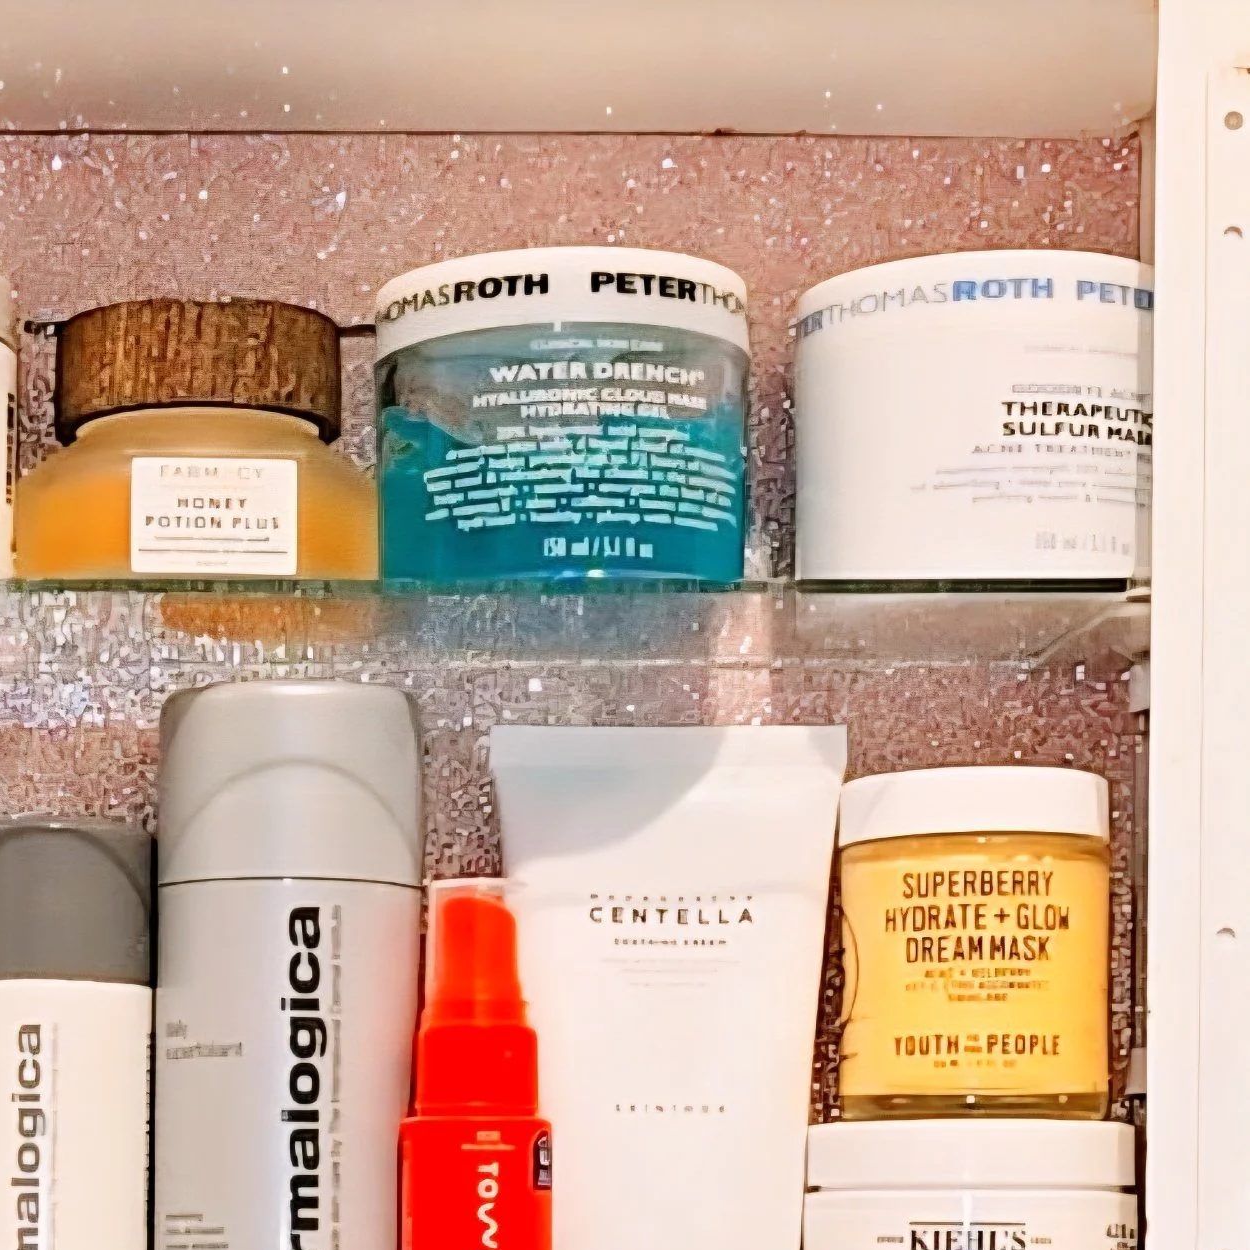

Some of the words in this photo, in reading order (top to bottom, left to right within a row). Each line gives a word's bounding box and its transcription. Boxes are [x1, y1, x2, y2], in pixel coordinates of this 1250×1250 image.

[490, 362, 586, 383] WATER
[1002, 421, 1100, 439] SULFUR
[160, 465, 264, 480] FARMCY
[178, 498, 247, 509] HONEY
[145, 515, 222, 529] POTION
[232, 517, 280, 529] PLUS
[902, 870, 1053, 899] SUPERBERRY
[589, 906, 753, 925] CENTELLA
[885, 903, 988, 932] HYDRATE
[1016, 903, 1070, 930] GLOW
[906, 935, 983, 963] DREAM
[990, 935, 1051, 962] MASK
[894, 1034, 959, 1056] YOUTH
[987, 1034, 1061, 1056] PEOPLE
